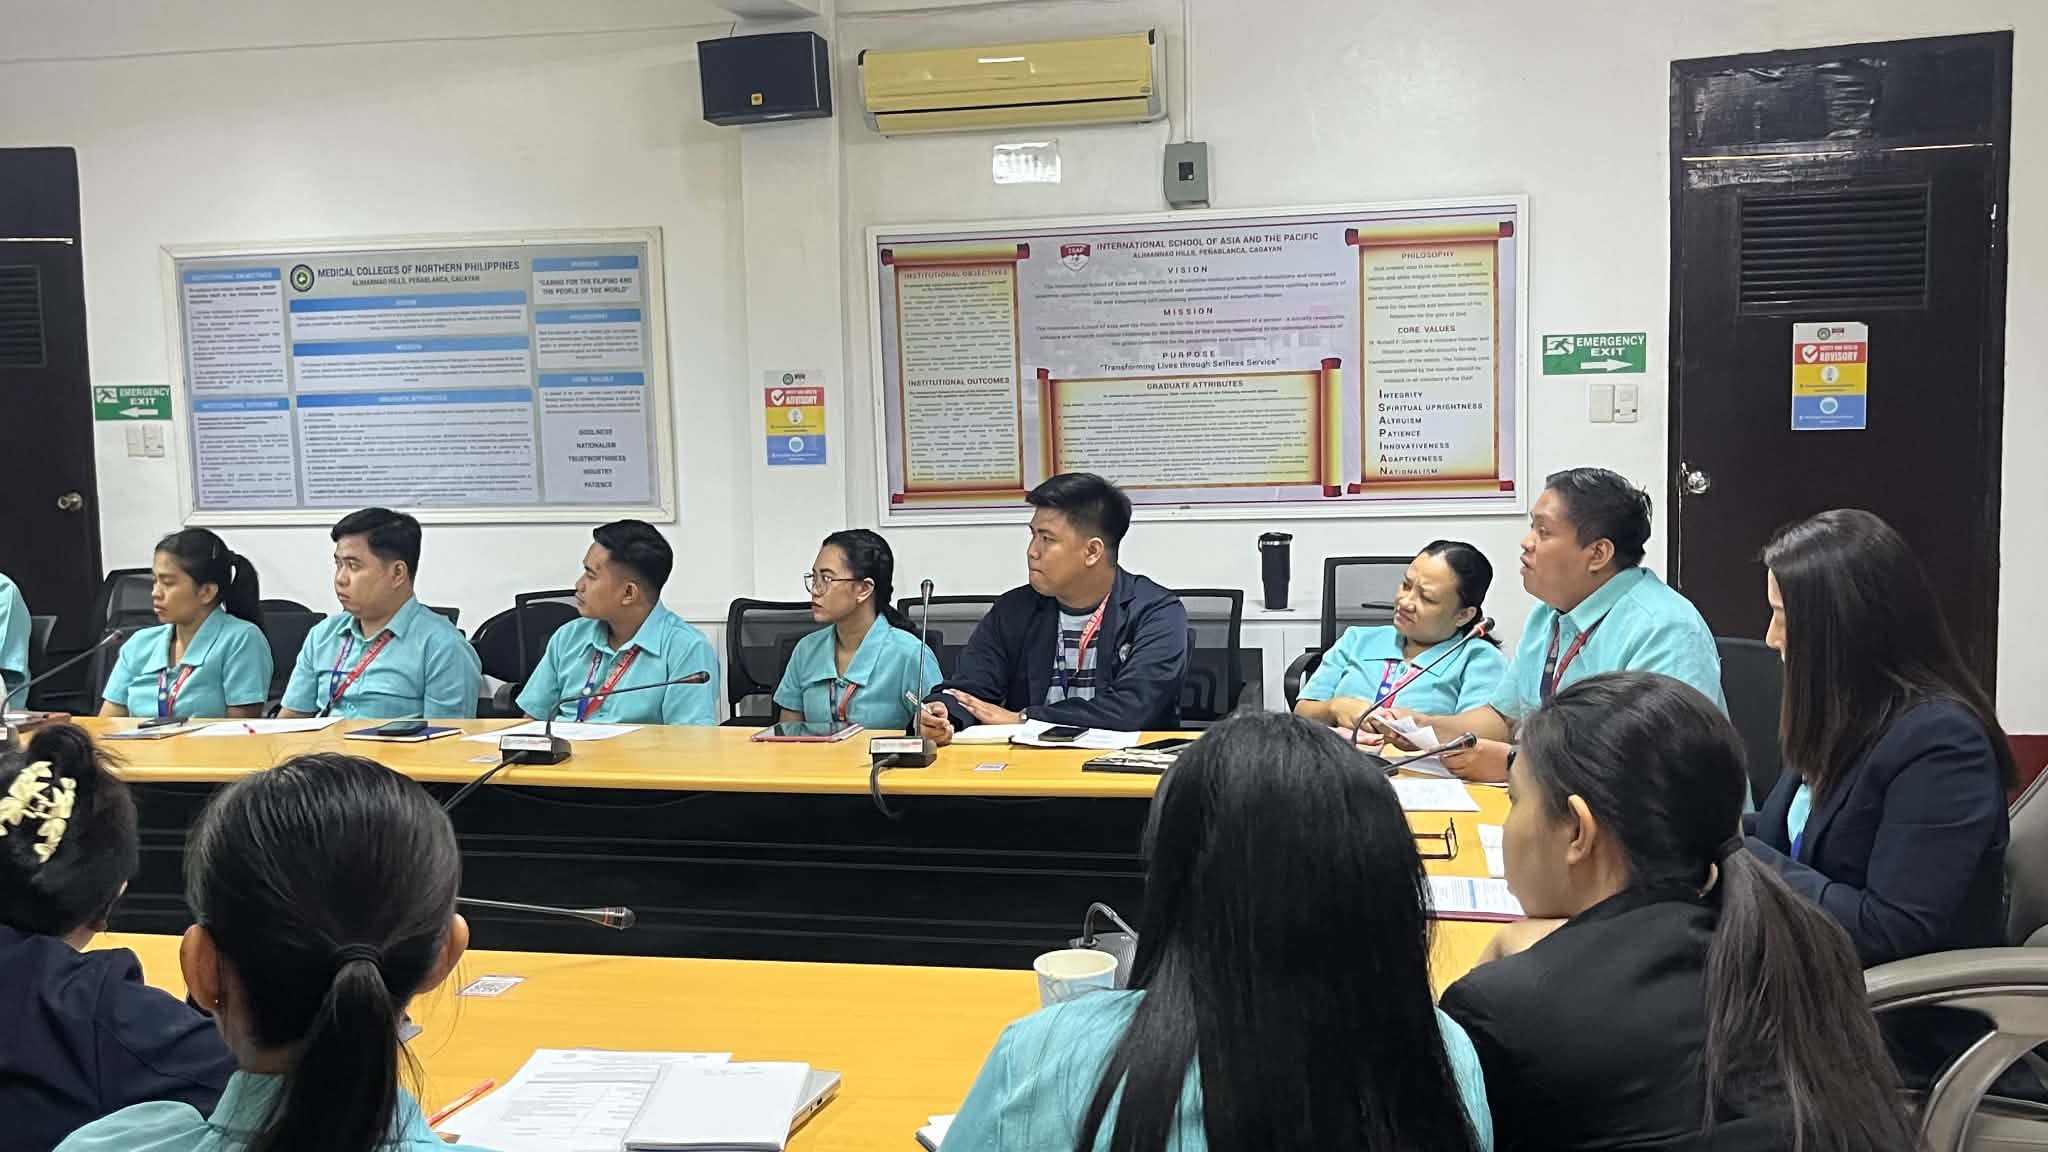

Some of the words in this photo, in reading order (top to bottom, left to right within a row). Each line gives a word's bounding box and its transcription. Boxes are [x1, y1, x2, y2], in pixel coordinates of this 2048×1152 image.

[1097, 240, 1165, 250] INTERNATIONAL
[1168, 238, 1203, 248] SCHOOL
[1206, 237, 1218, 245] OF
[1220, 236, 1241, 244] ASIA
[1243, 235, 1262, 243] AND
[1264, 234, 1281, 242] THE
[1284, 232, 1319, 241] PACIFIC
[1249, 245, 1282, 253] CAGAYAN
[1401, 251, 1455, 259] PHILOSOPHY
[318, 267, 355, 278] MEDICAL
[357, 265, 400, 276] COLLEGES
[402, 264, 412, 274] OF
[415, 263, 462, 273] NORTHERN
[464, 260, 520, 272] PHILIPPINES
[1168, 265, 1208, 274] VISION
[904, 271, 960, 280] INSTITUTIONAL
[962, 270, 1008, 278] OBJECTIVES
[1163, 307, 1213, 316] MISSION
[1398, 326, 1420, 334] CORE
[1424, 324, 1456, 333] VALUES
[1576, 335, 1645, 347] EMERGENCY
[1162, 350, 1216, 359] PURPOSE
[1590, 347, 1625, 357] EXIT
[1157, 361, 1178, 369] Lives
[1180, 360, 1211, 369] through
[1213, 359, 1244, 367] Selfless
[908, 378, 965, 387] INSTITUTIONAL
[967, 377, 1010, 385] OUTCOMES
[1147, 381, 1190, 391] GRADUATE
[1192, 380, 1243, 389] ATTRIBUTES
[120, 387, 169, 397] EMERGENCY
[1379, 389, 1423, 399] INTEGRITY
[130, 397, 156, 406] EXIT
[1378, 402, 1422, 412] SPIRITUAL
[1425, 403, 1483, 411] UPRIGHTNESS
[1379, 415, 1422, 425] ALTRUISM
[1379, 428, 1421, 438] PATIENCE
[576, 441, 616, 449] NATIONALISM
[1379, 441, 1450, 450] INNOVATIVENESS
[1380, 454, 1443, 463] ADAPTIVENESS
[584, 481, 613, 489] PATIENCE
